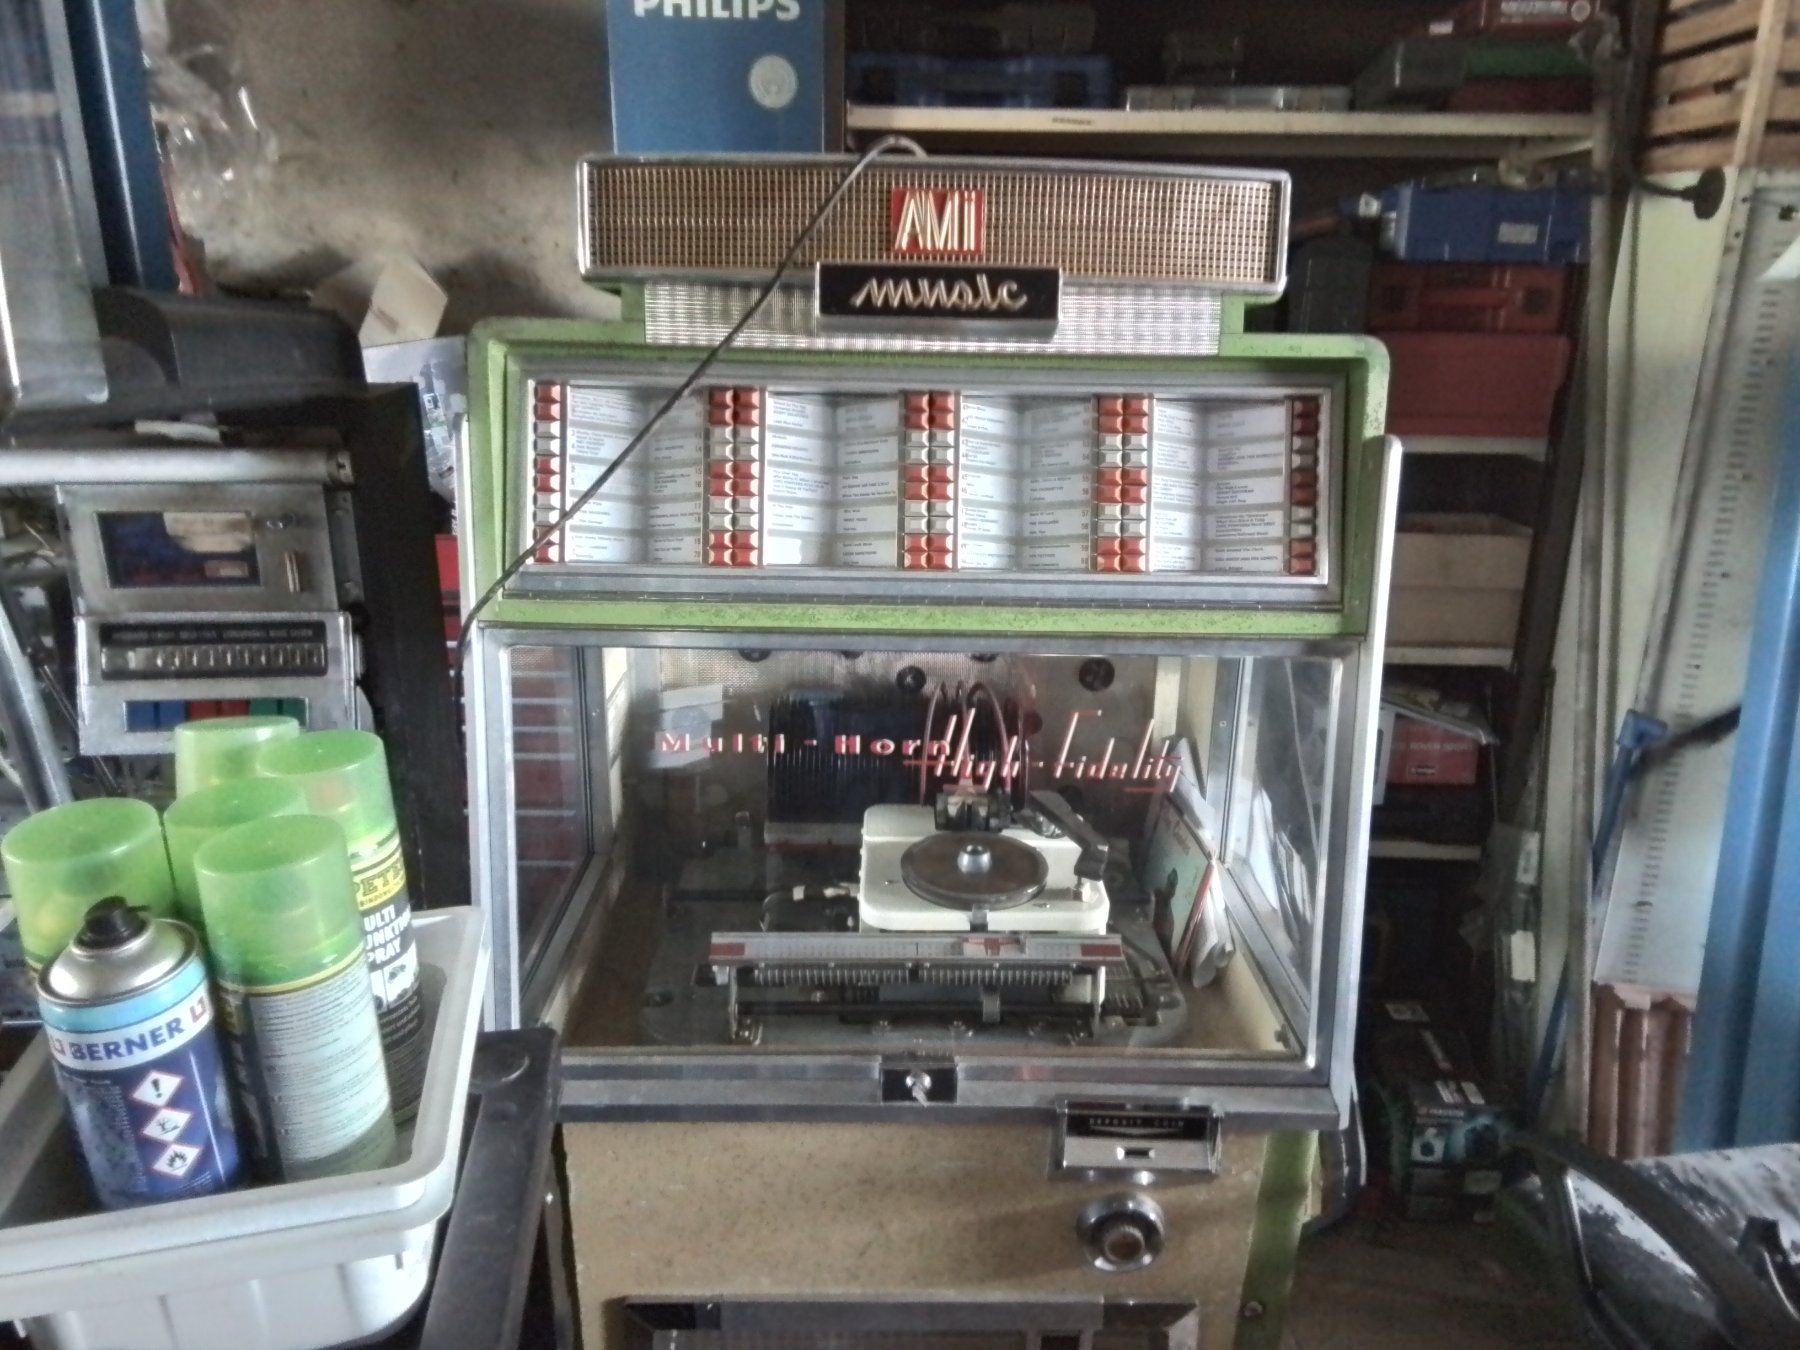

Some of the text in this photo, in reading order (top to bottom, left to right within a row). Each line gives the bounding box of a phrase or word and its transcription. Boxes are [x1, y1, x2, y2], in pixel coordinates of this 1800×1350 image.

[633, 0, 800, 21] PHILIPS
[363, 904, 395, 931] ULTI
[68, 1016, 185, 1061] BERNER
